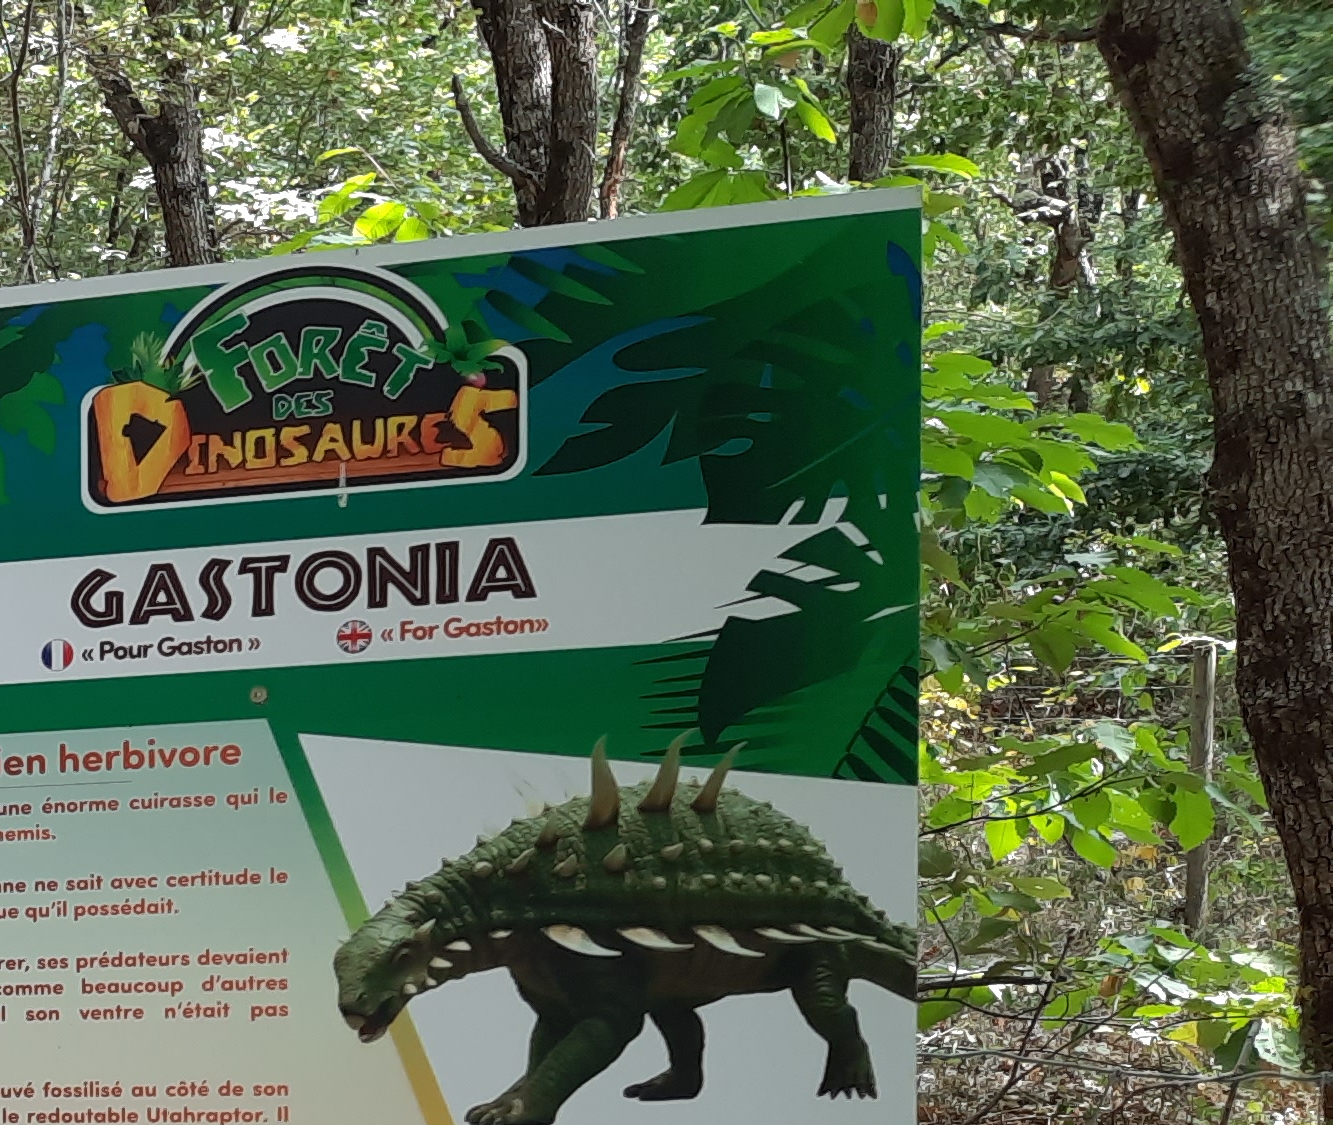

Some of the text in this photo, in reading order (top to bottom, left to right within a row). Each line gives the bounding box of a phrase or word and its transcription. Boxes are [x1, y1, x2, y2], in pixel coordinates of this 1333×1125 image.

[190, 311, 436, 413] FORÊT
[272, 390, 333, 420] DES
[93, 380, 517, 502] DINOSAURES
[70, 535, 536, 628] GASTONIA
[399, 619, 438, 641] For
[99, 640, 149, 662] Pour
[157, 635, 243, 658] Gaston
[59, 741, 241, 773] herbivore
[41, 796, 119, 814] énorme
[129, 792, 216, 810] cuirasse
[226, 787, 258, 810] qui
[269, 787, 288, 804] le
[34, 880, 58, 892] ne
[66, 873, 103, 891] sait
[110, 876, 158, 890] avec
[166, 868, 261, 888] certitude
[270, 867, 288, 884] le
[25, 901, 67, 923] qu'il
[74, 898, 178, 922] possédait.
[37, 957, 69, 970] ses
[76, 951, 190, 974] prédateurs
[197, 947, 288, 966] devaient
[81, 977, 183, 997] beaucoup
[201, 975, 288, 992] d'autres
[25, 1009, 60, 1022] son
[79, 1004, 144, 1020] ventre
[164, 1001, 230, 1019] n'était
[251, 1005, 289, 1022] pas
[43, 1080, 123, 1098] fossilisé
[131, 1086, 156, 1097] au
[165, 1080, 210, 1097] côté
[218, 1080, 244, 1097] de
[253, 1084, 288, 1097] son
[2, 1107, 20, 1124] le
[27, 1107, 139, 1124] redoutable
[277, 1105, 288, 1122] Il
